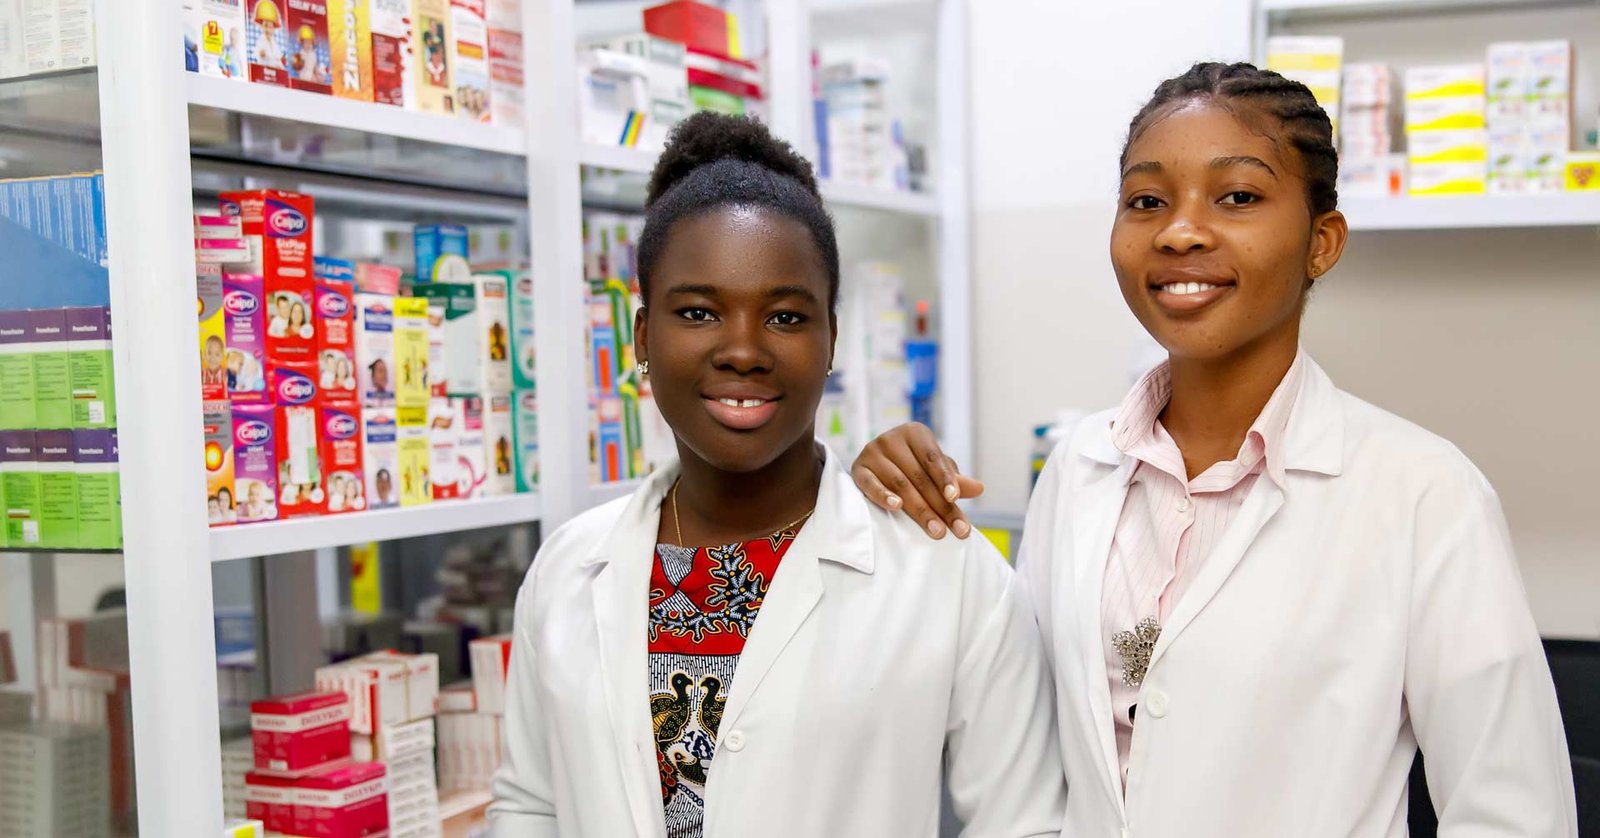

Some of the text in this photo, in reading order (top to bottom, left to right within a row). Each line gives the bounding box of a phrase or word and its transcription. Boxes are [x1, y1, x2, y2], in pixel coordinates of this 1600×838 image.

[275, 215, 304, 231] Calpol
[277, 239, 306, 250] SixPlus
[227, 296, 255, 311] Calpol
[323, 298, 347, 310] Calpol
[284, 382, 313, 397] Calpol
[241, 425, 268, 441] Calpol
[332, 419, 356, 433] Calpol
